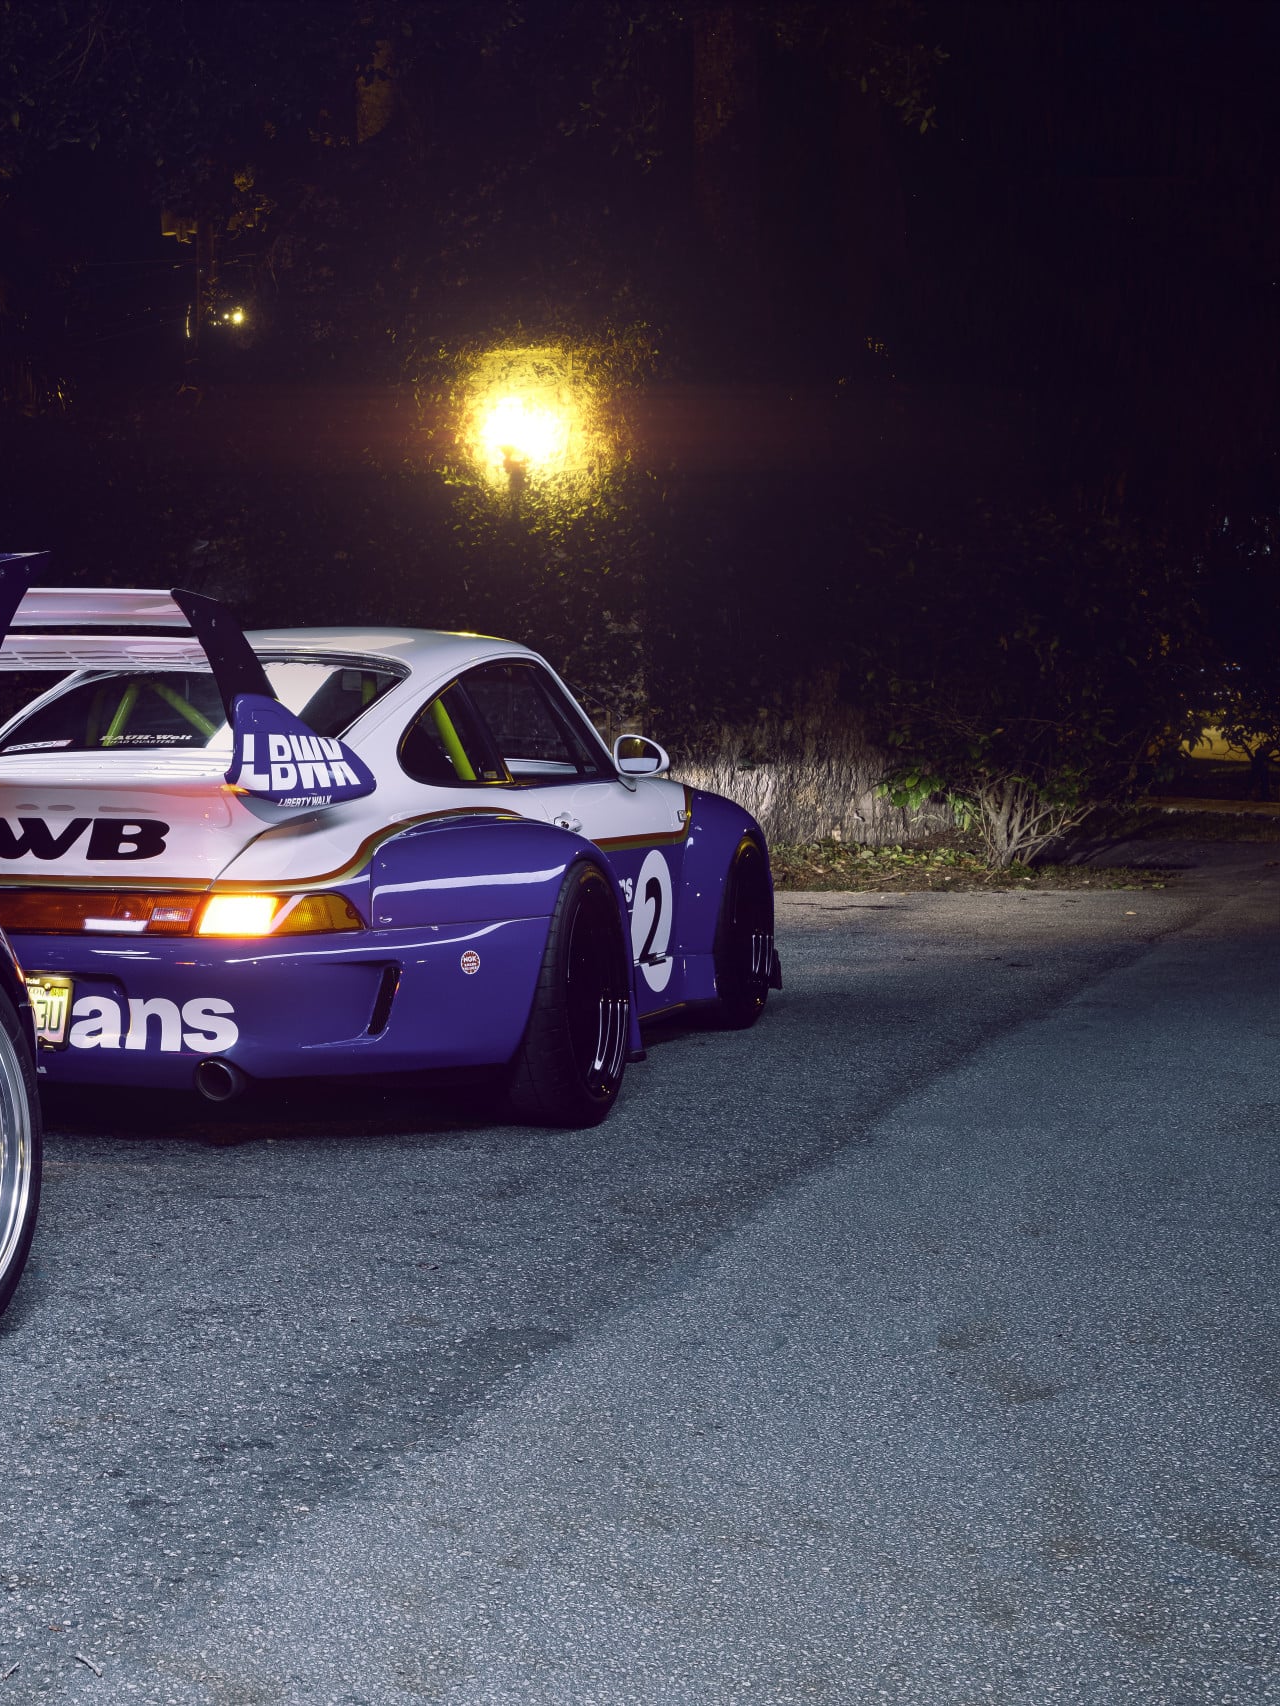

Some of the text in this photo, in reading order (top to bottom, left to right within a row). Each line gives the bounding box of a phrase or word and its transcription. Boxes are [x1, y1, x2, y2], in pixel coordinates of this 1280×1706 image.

[277, 795, 332, 807] LIBERTY WALK
[639, 876, 667, 967] 2
